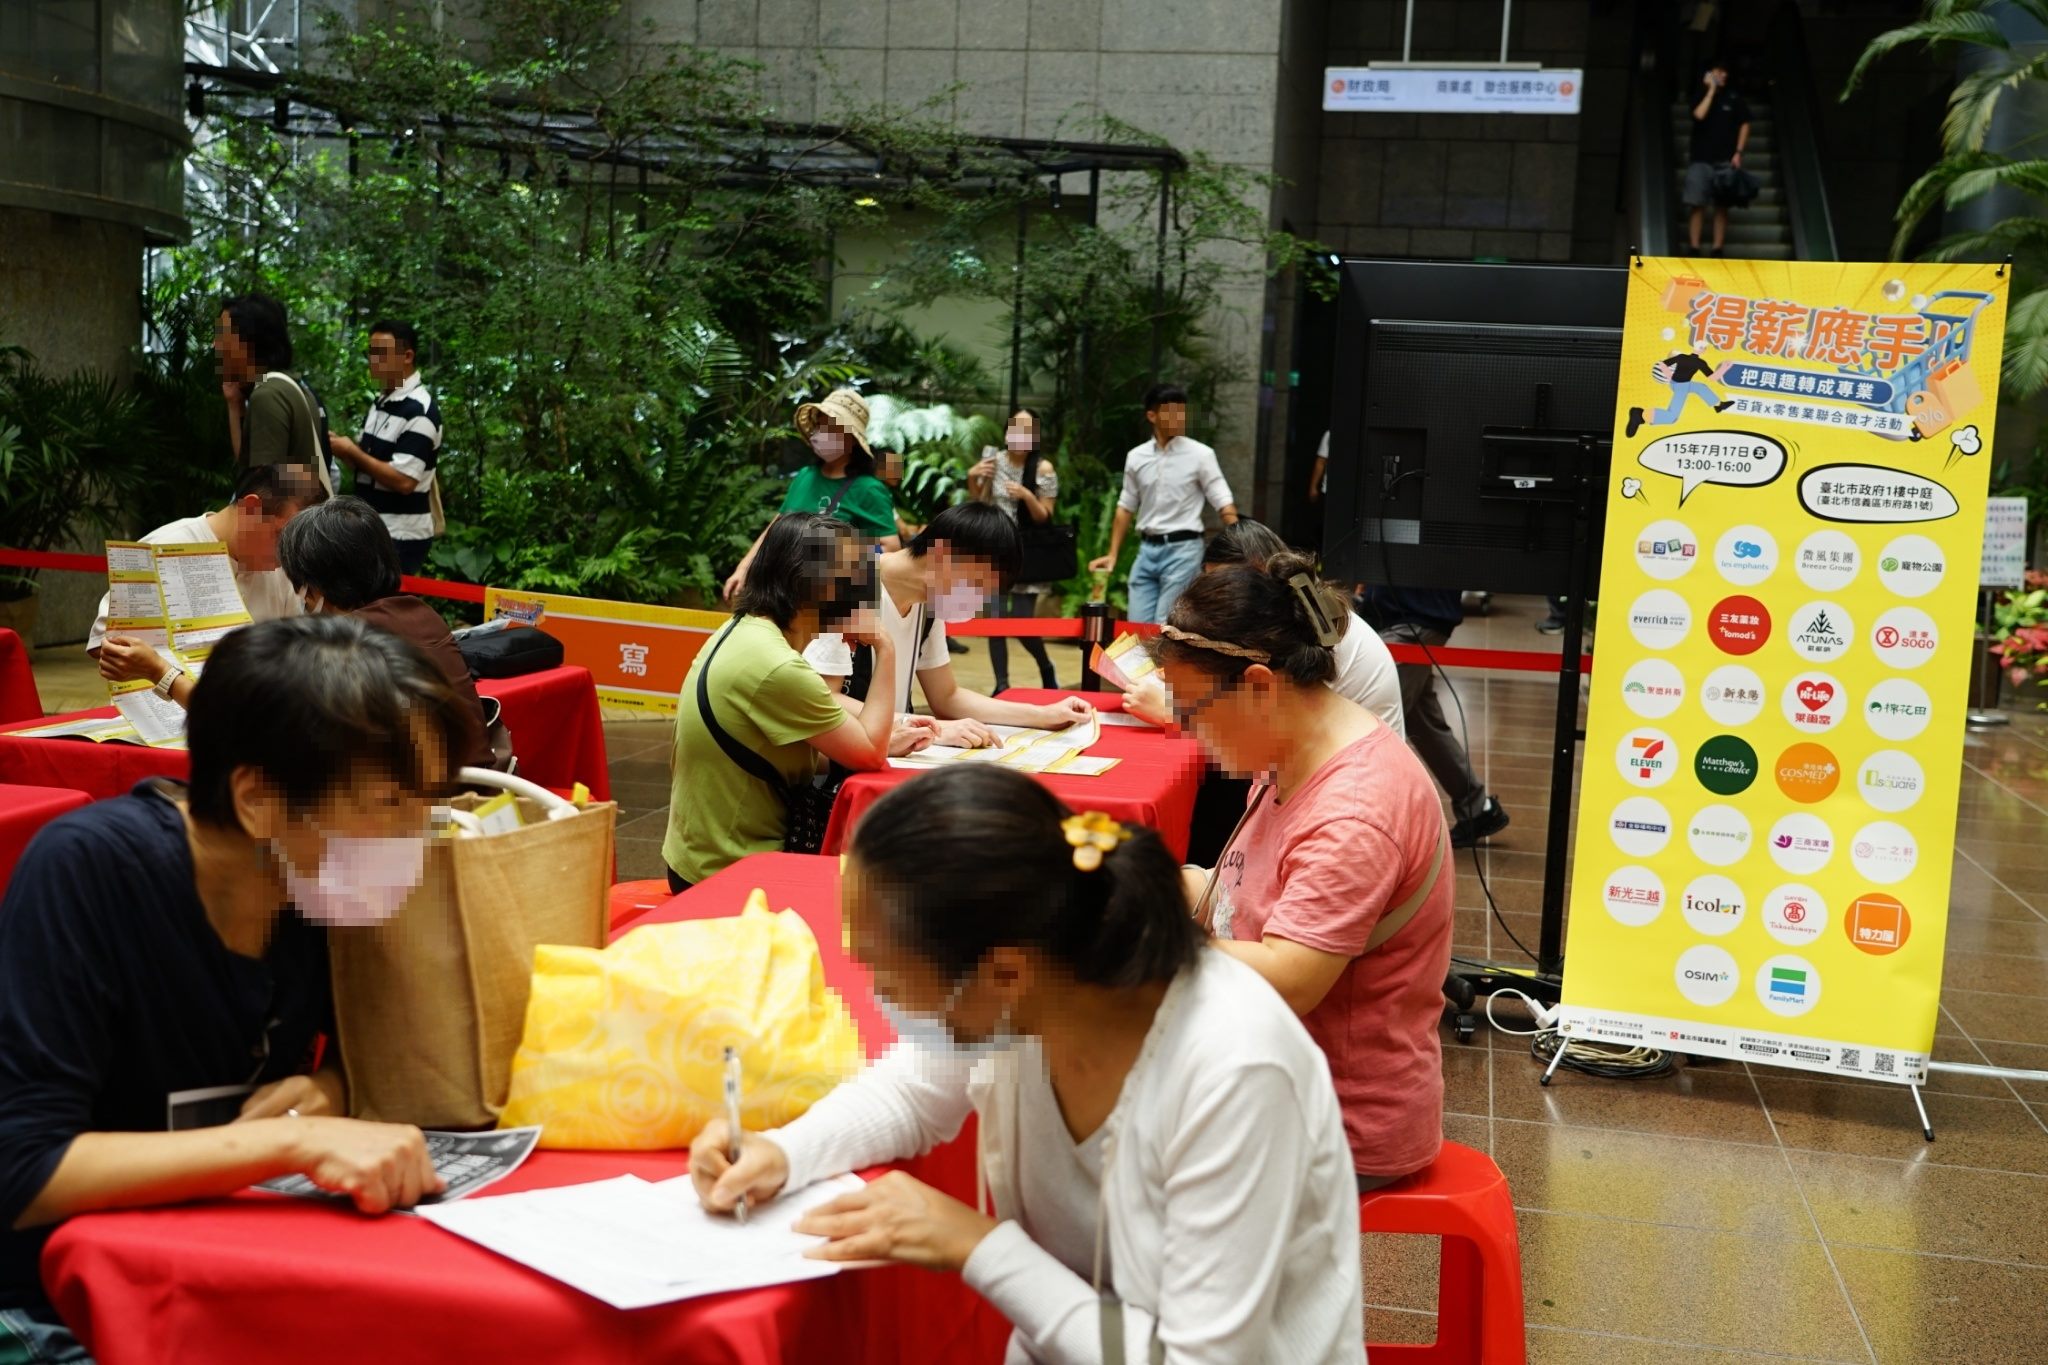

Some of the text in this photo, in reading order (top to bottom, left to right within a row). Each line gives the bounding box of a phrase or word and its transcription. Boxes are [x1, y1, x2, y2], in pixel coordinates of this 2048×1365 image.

[1484, 81, 1556, 95] 聯合服務中心
[1739, 368, 1875, 401] 把興趣轉成專業
[1664, 442, 1749, 458] 115年7月17日
[1676, 458, 1752, 473] 13:00-16:00
[1819, 481, 1934, 500] 臺北市政府1樓中庭
[1816, 495, 1934, 512] (臺北市信義區市府路1號)
[1803, 549, 1854, 564] 微風集團
[1721, 560, 1769, 571] les enphants
[1801, 562, 1853, 572] Breeze Group
[1901, 560, 1943, 573] 寵物公園
[1633, 614, 1669, 626] everrich
[1719, 613, 1760, 626] 三友藥妝
[1724, 629, 1756, 640] Tomod's
[1796, 634, 1844, 646] ATUNAS
[1901, 638, 1935, 649] SOGO
[618, 642, 649, 677] 寫
[1723, 687, 1759, 701] 新東陽
[1799, 686, 1830, 703] Hi-Life
[1884, 702, 1927, 717] 棉花田
[1702, 755, 1745, 768] Matthew's
[1723, 765, 1750, 775] choice
[1779, 768, 1828, 781] COSMED
[1608, 885, 1660, 903] 新光三越
[1684, 970, 1719, 982] OSIM
[1769, 994, 1804, 1005] FamilyMart
